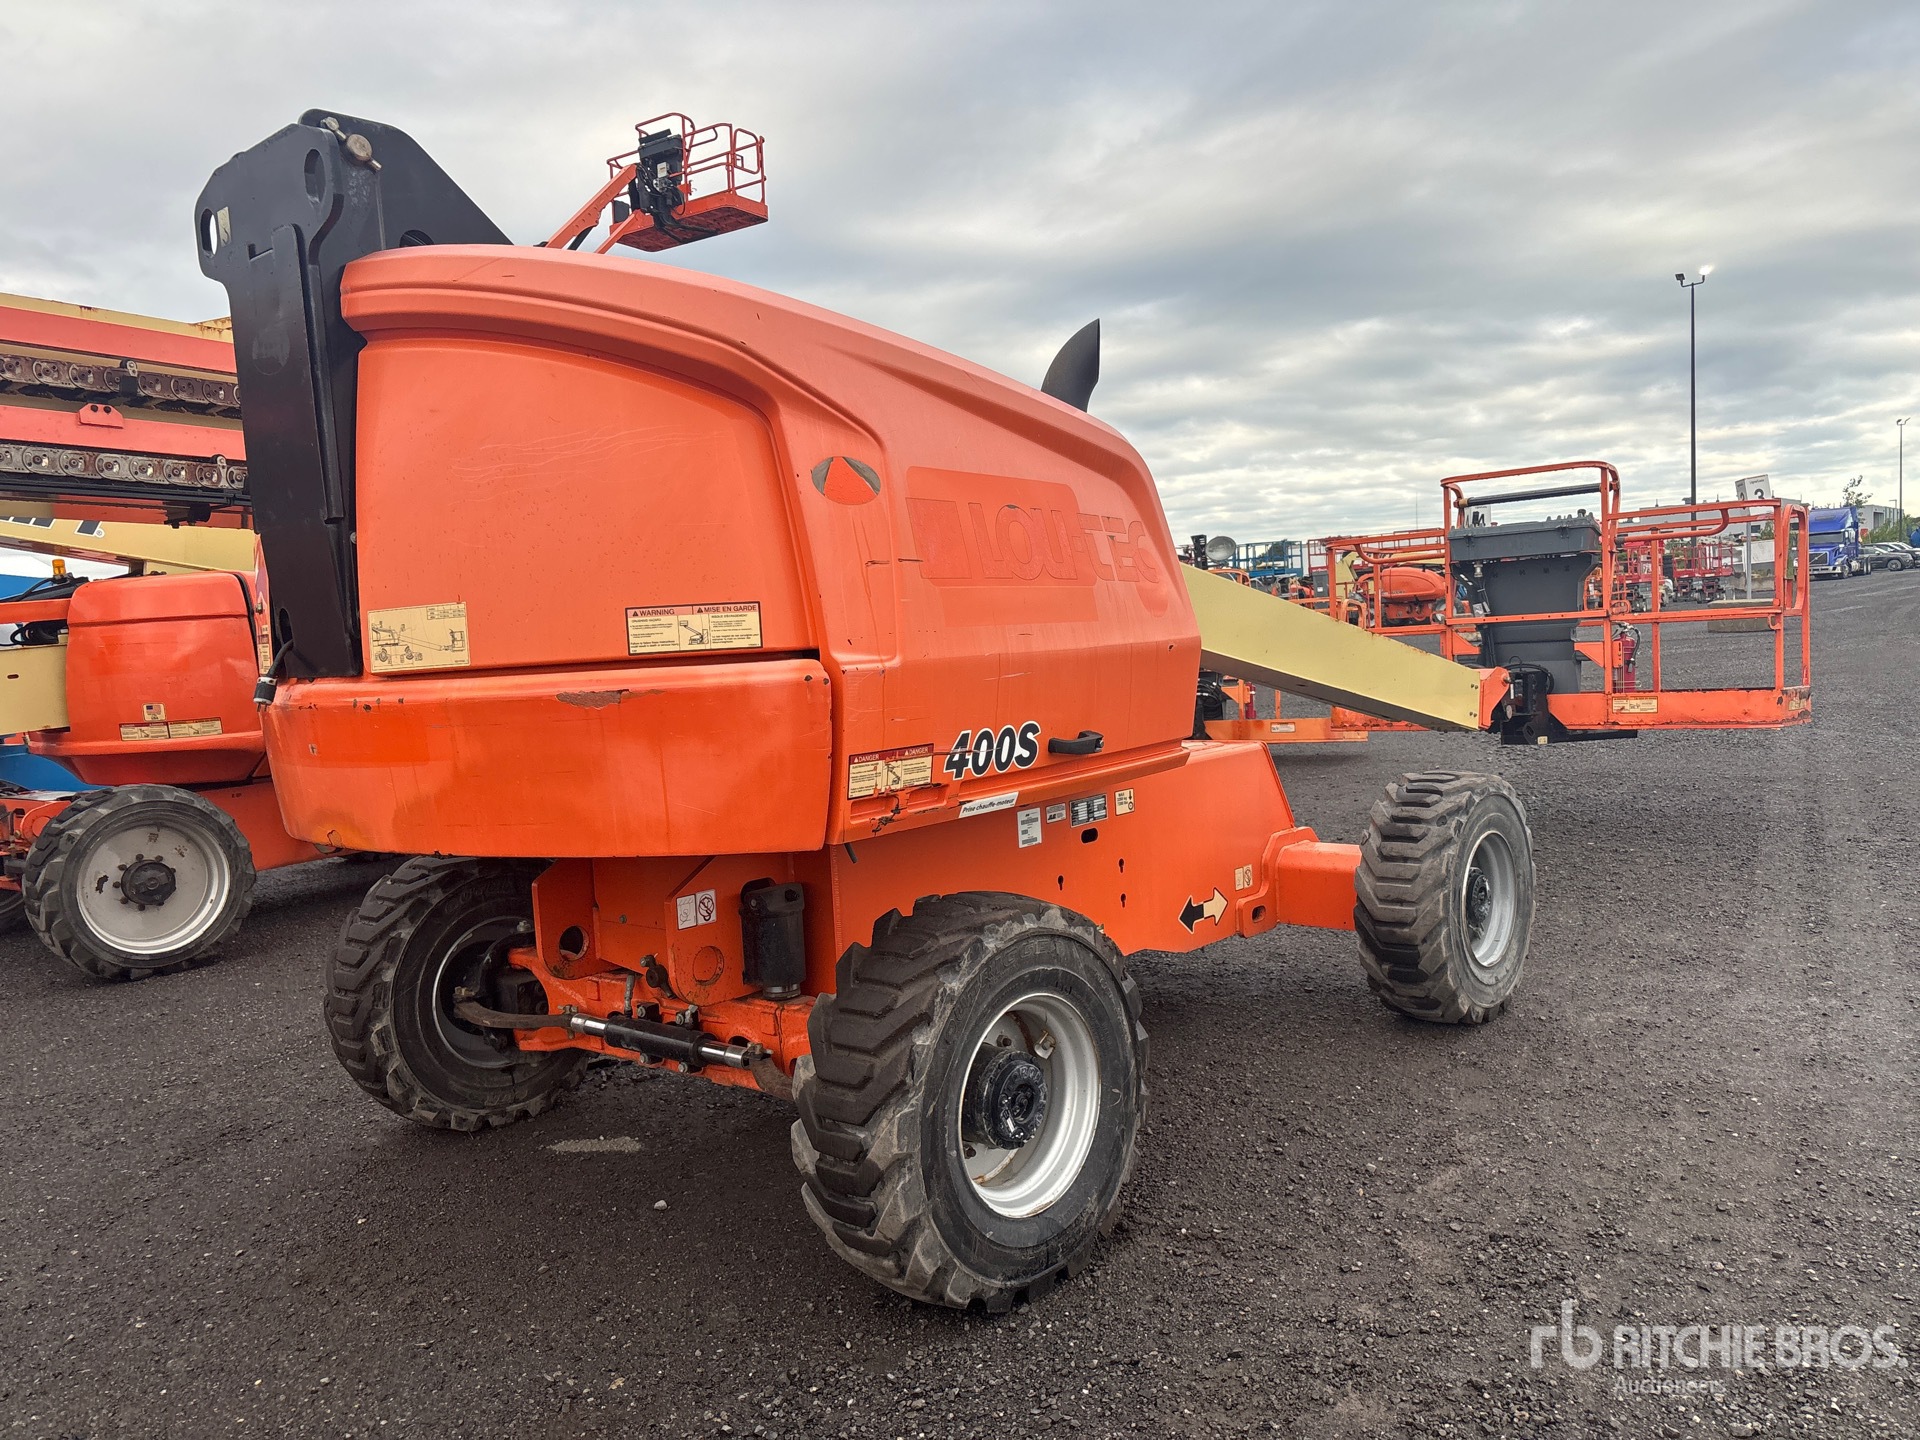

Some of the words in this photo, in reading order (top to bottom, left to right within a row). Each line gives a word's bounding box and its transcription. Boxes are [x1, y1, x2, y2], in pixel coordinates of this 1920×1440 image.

[639, 608, 675, 617] WARNING
[733, 604, 757, 612] GARDE
[908, 746, 929, 756] DANGER
[943, 720, 1041, 780] 400S
[858, 754, 880, 763] DANGER
[962, 805, 976, 813] Prise
